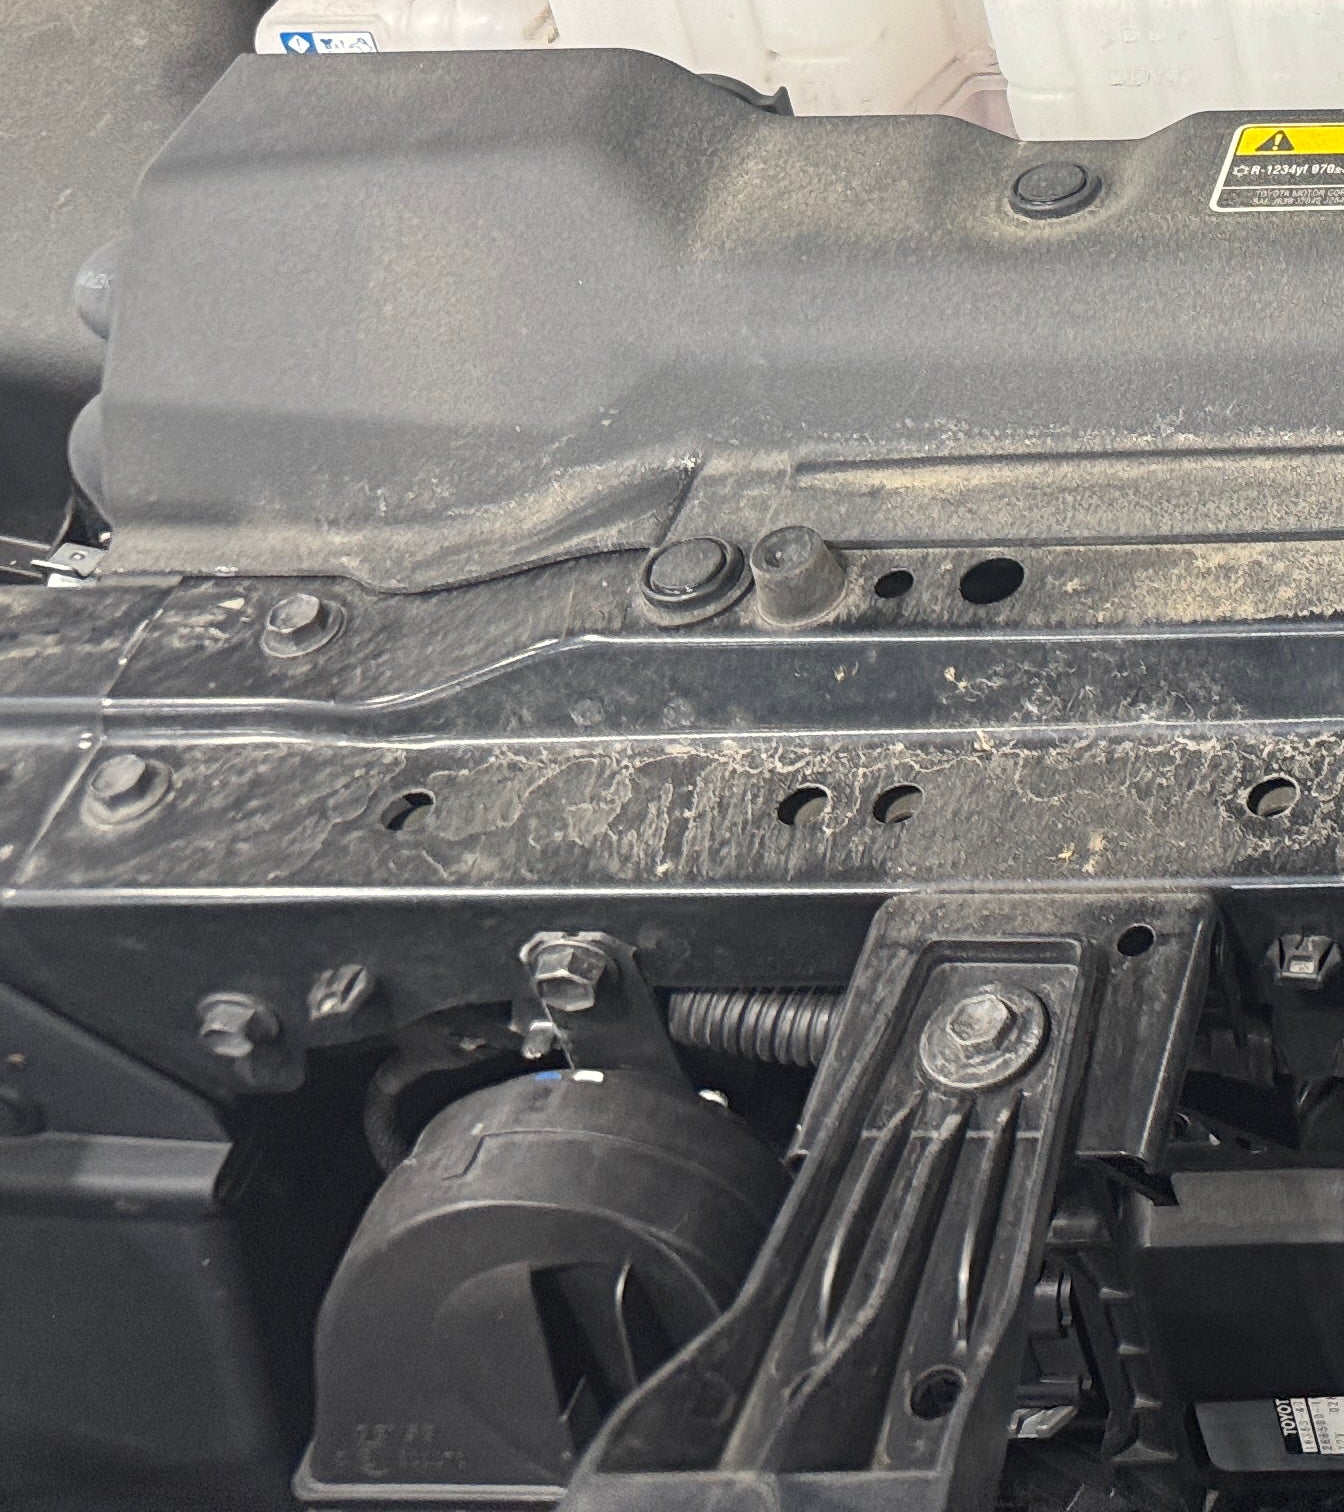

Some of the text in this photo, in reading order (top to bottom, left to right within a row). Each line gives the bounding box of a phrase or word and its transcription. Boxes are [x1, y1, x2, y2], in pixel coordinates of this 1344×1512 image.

[1250, 163, 1309, 178] R-1234yf
[1255, 189, 1291, 198] TOYOTA
[1291, 188, 1326, 198] MOTOR
[1275, 1398, 1298, 1437] TOYOT
